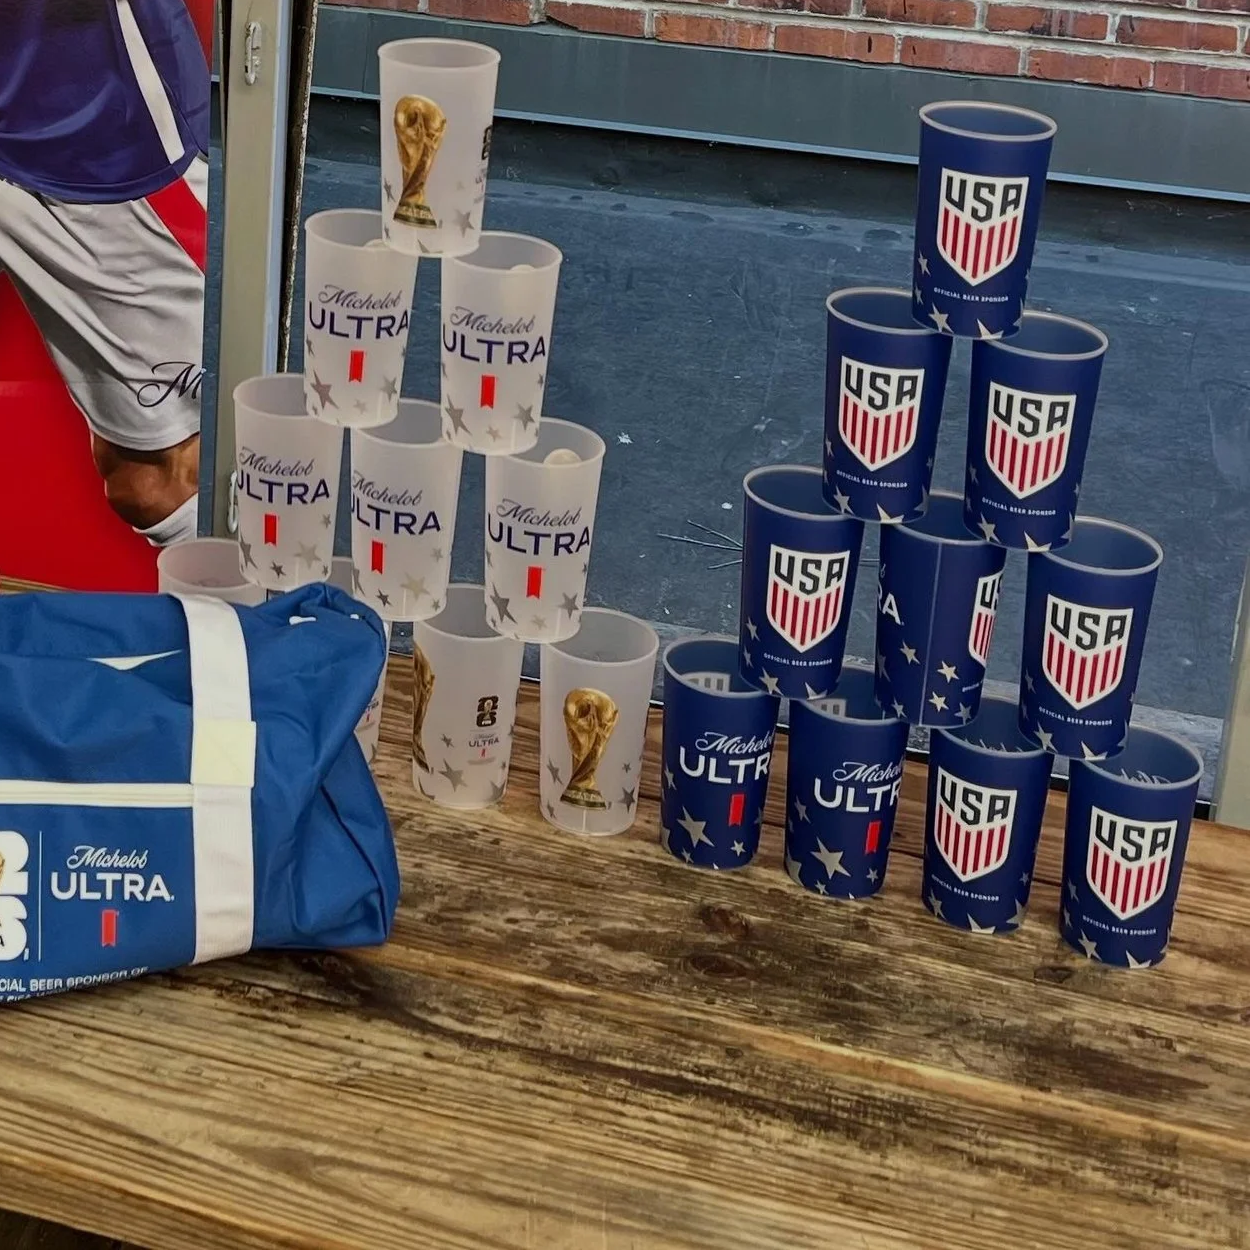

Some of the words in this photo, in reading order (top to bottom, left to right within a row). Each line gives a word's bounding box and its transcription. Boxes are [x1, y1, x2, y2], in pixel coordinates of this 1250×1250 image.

[945, 175, 1022, 223] USA
[318, 284, 402, 310] Michelob
[309, 301, 408, 339] ULTRA
[450, 306, 536, 334] Michelob
[443, 323, 546, 365] ULTRA
[845, 363, 919, 411] USA
[994, 388, 1070, 438] USA
[238, 446, 315, 477] Michelob
[352, 470, 423, 505] Michelob
[496, 498, 582, 526] Michelob
[488, 512, 590, 556] ULTRA
[774, 551, 845, 596] USA
[1051, 604, 1126, 651] USA
[679, 746, 771, 784] ULTR
[814, 776, 901, 813] ULTR
[939, 774, 1011, 827] USA
[66, 845, 148, 870] Michelob
[1095, 814, 1170, 863] USA
[51, 871, 172, 901] ULTRA
[29, 978, 63, 992] BEER
[130, 965, 149, 976] OF
